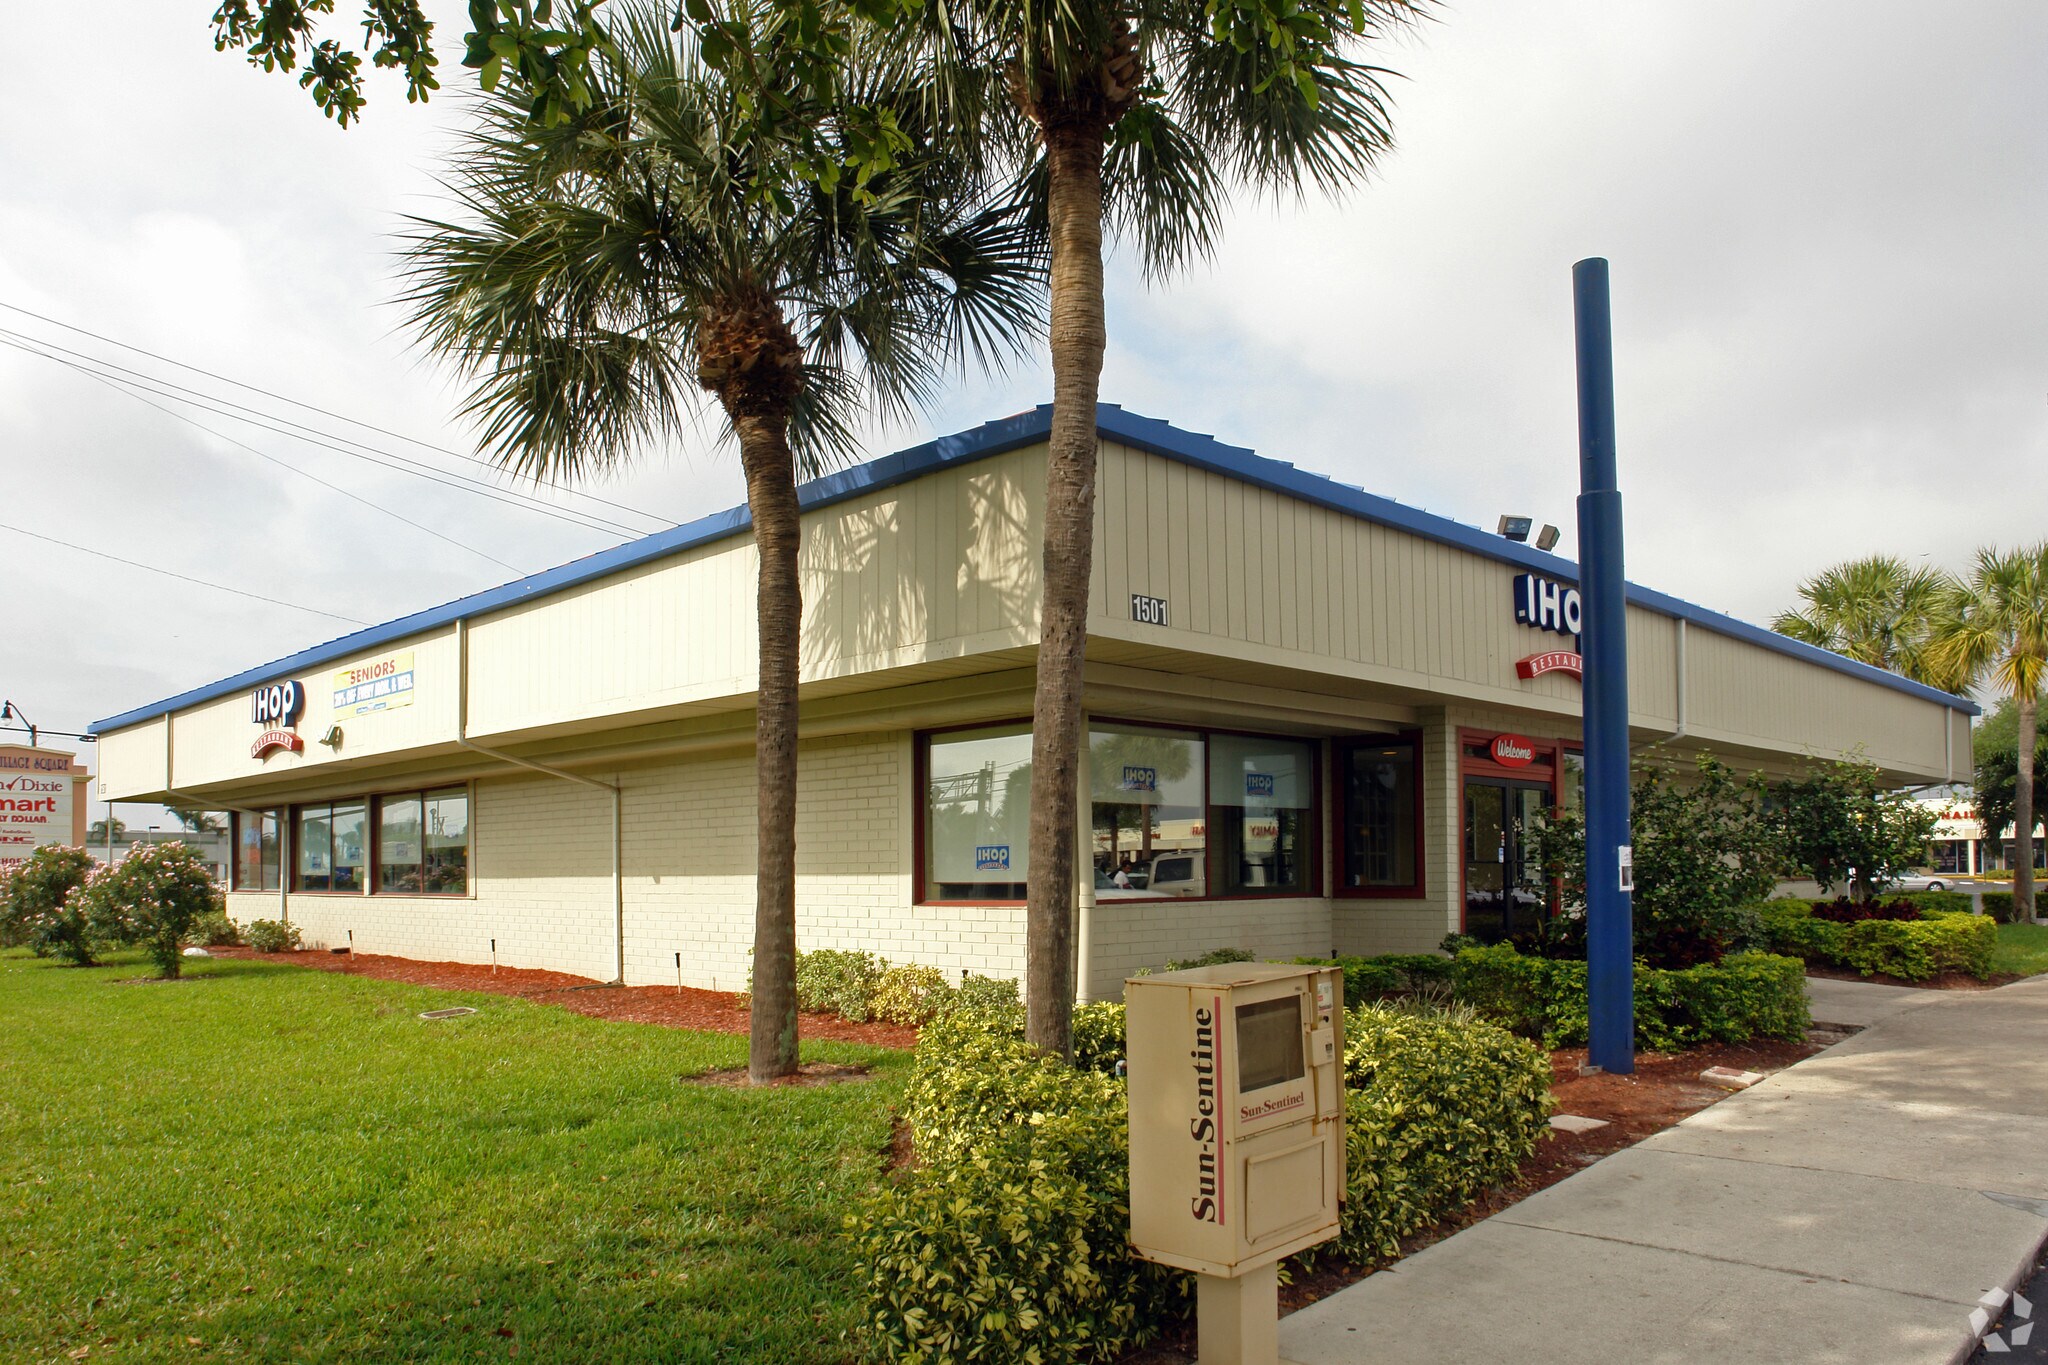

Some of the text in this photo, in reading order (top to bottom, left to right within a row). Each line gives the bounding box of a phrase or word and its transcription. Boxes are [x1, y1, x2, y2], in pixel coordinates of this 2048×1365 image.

[1133, 596, 1167, 625] 1501
[1527, 574, 1582, 634] IHO
[350, 659, 395, 685] SENIORS
[252, 680, 295, 727] IHOP
[1497, 739, 1532, 760] Welcome
[20, 778, 63, 792] Dixie
[1125, 768, 1154, 786] IHOP
[1248, 775, 1272, 791] IHOP
[11, 815, 47, 824] DOLLAR
[977, 848, 1008, 864] IHOP
[1240, 1091, 1304, 1119] Sun-Sentinel
